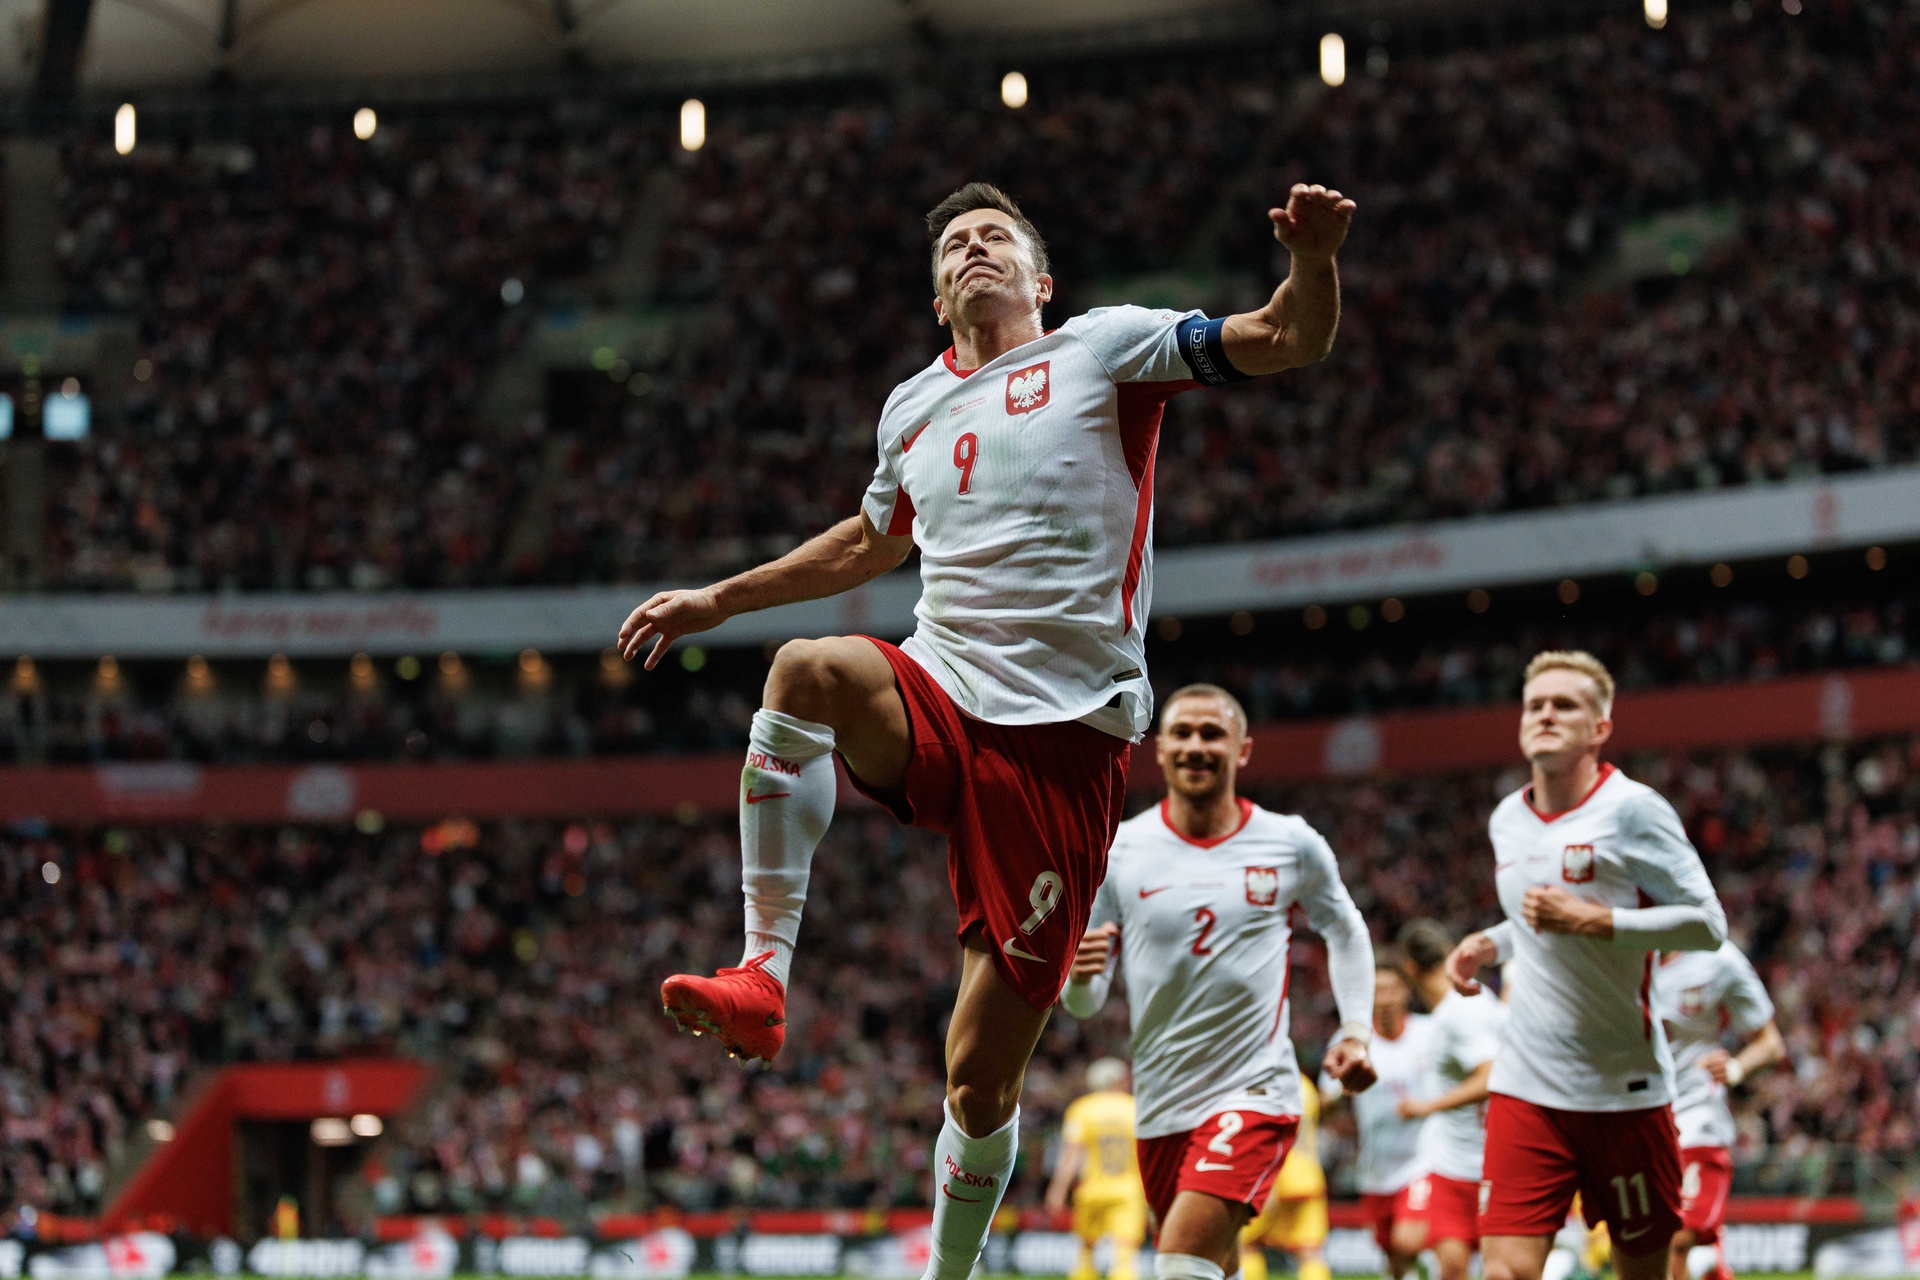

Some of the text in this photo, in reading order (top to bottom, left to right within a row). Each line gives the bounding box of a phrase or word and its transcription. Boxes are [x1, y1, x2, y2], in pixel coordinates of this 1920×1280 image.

[1193, 327, 1214, 374] RESPECT
[953, 432, 979, 496] 9
[748, 752, 802, 778] POLSKA
[1019, 870, 1063, 936] 9
[1191, 906, 1216, 956] 2
[1207, 1111, 1244, 1157] 2
[945, 1154, 994, 1188] POLSKA
[1610, 1172, 1650, 1219] 11
